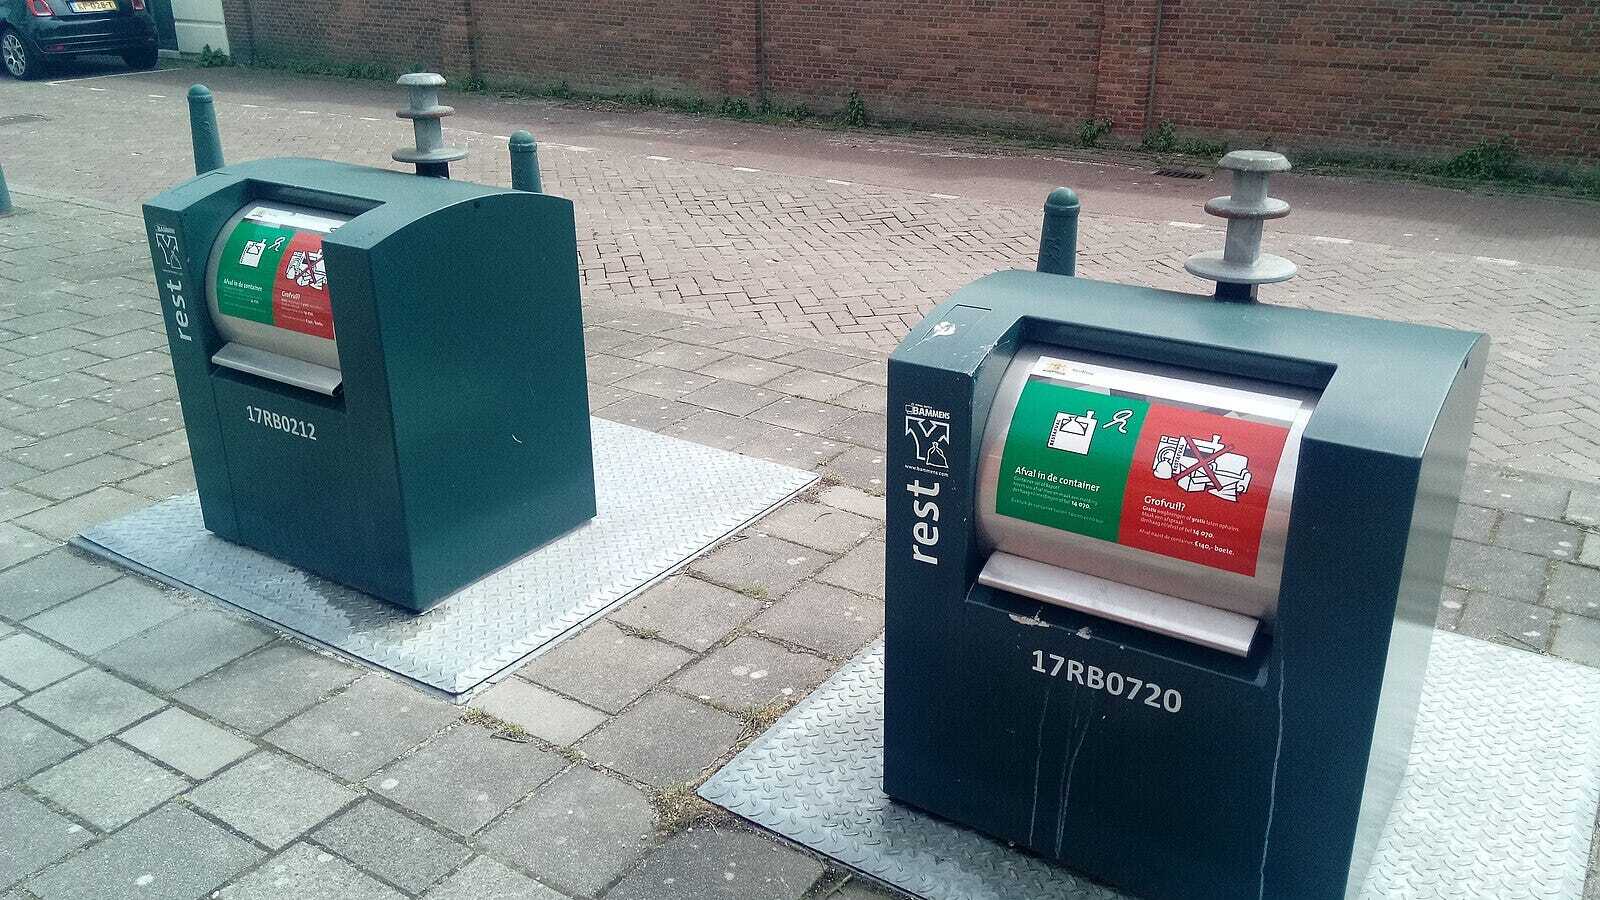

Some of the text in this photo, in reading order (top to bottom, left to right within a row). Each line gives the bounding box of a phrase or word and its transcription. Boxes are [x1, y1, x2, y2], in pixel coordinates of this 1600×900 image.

[167, 279, 192, 341] rest
[246, 405, 317, 441] 17RB0212
[912, 406, 951, 419] BAMMENS
[1015, 466, 1036, 478] Afval
[1037, 471, 1046, 480] in
[1047, 473, 1058, 484] de
[1059, 477, 1101, 493] container
[1143, 495, 1185, 511] Grofvuil?
[906, 480, 940, 566] rest
[1192, 529, 1200, 537] 14
[1031, 650, 1182, 713] 17RB0720
